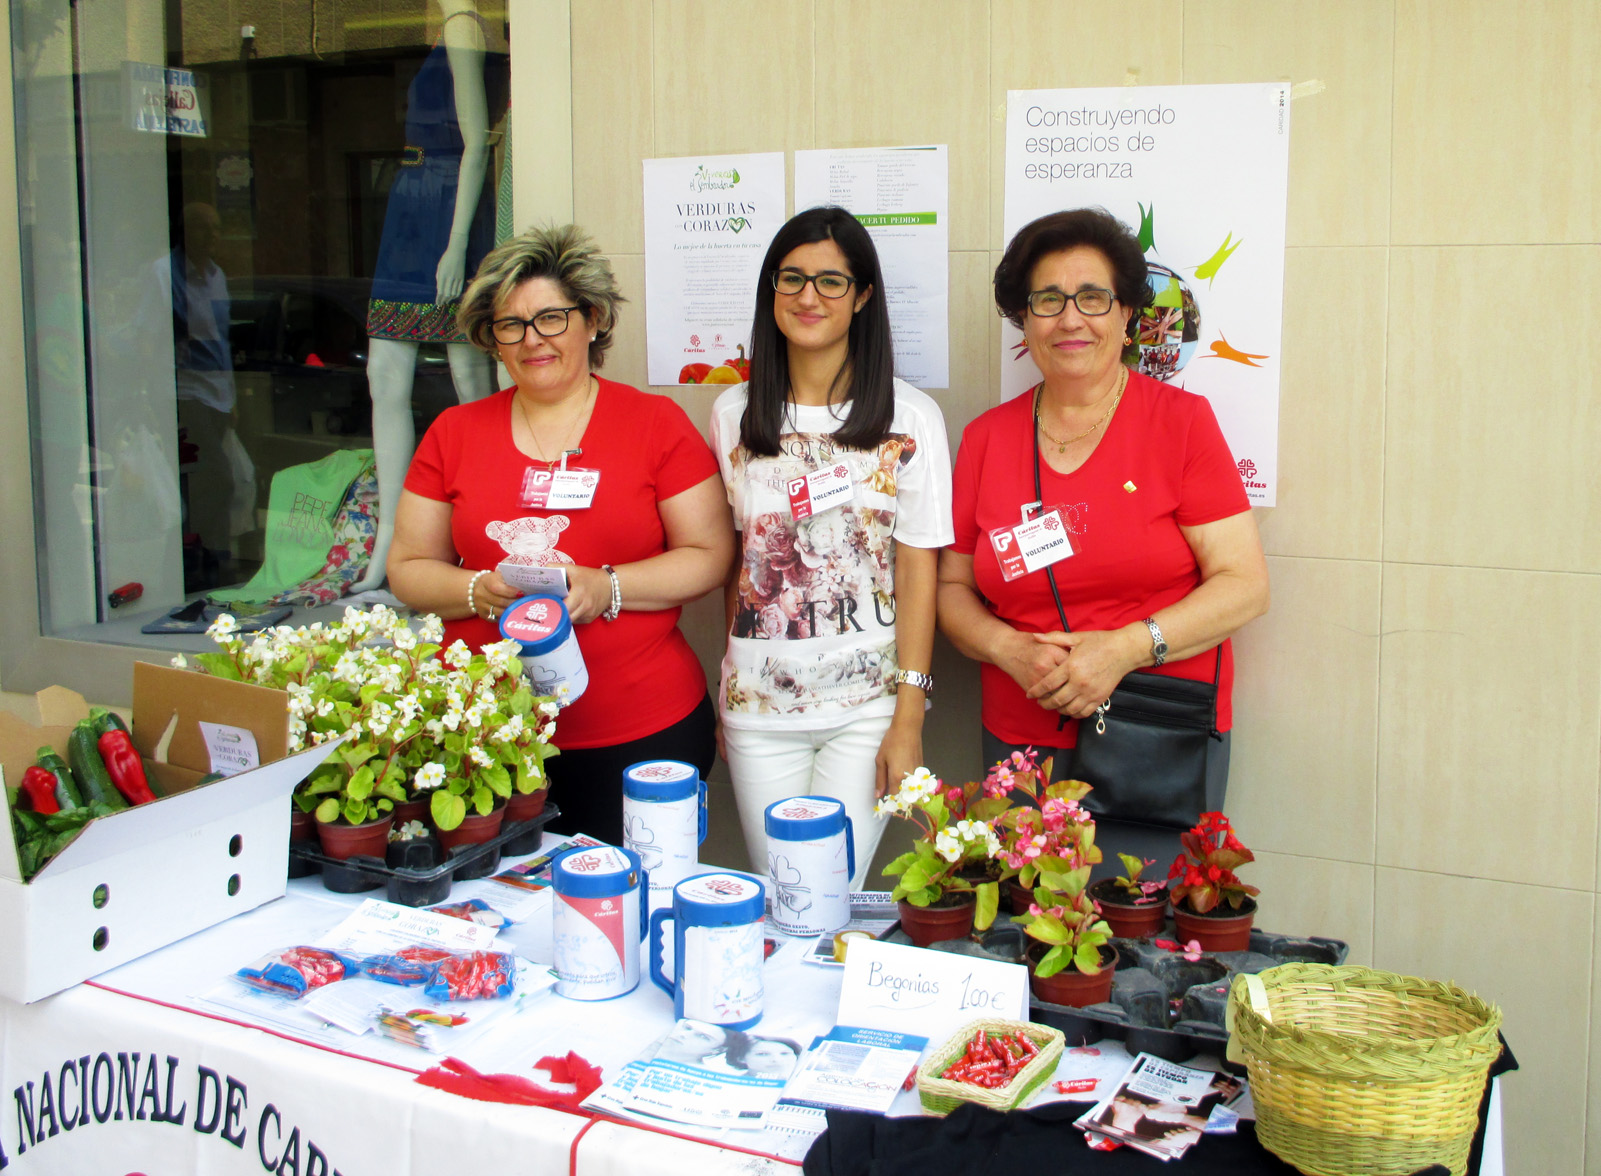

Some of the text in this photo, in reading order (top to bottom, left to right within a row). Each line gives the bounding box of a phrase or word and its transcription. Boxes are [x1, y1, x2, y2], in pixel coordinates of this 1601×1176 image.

[1025, 104, 1176, 130] Construyendo
[1025, 131, 1155, 157] espacios de
[1024, 162, 1133, 183] esperanza
[676, 201, 756, 217] VERDURAS
[856, 217, 879, 225] ACER
[890, 216, 920, 224] PEDIDO
[813, 484, 850, 502] VOLUNTARIO
[1025, 538, 1064, 558] VOLUNTARIO
[867, 961, 939, 1001] Begonias
[858, 1029, 893, 1038] SERVICIO
[14, 1052, 187, 1155] NACIONAL
[194, 1064, 248, 1149] DE
